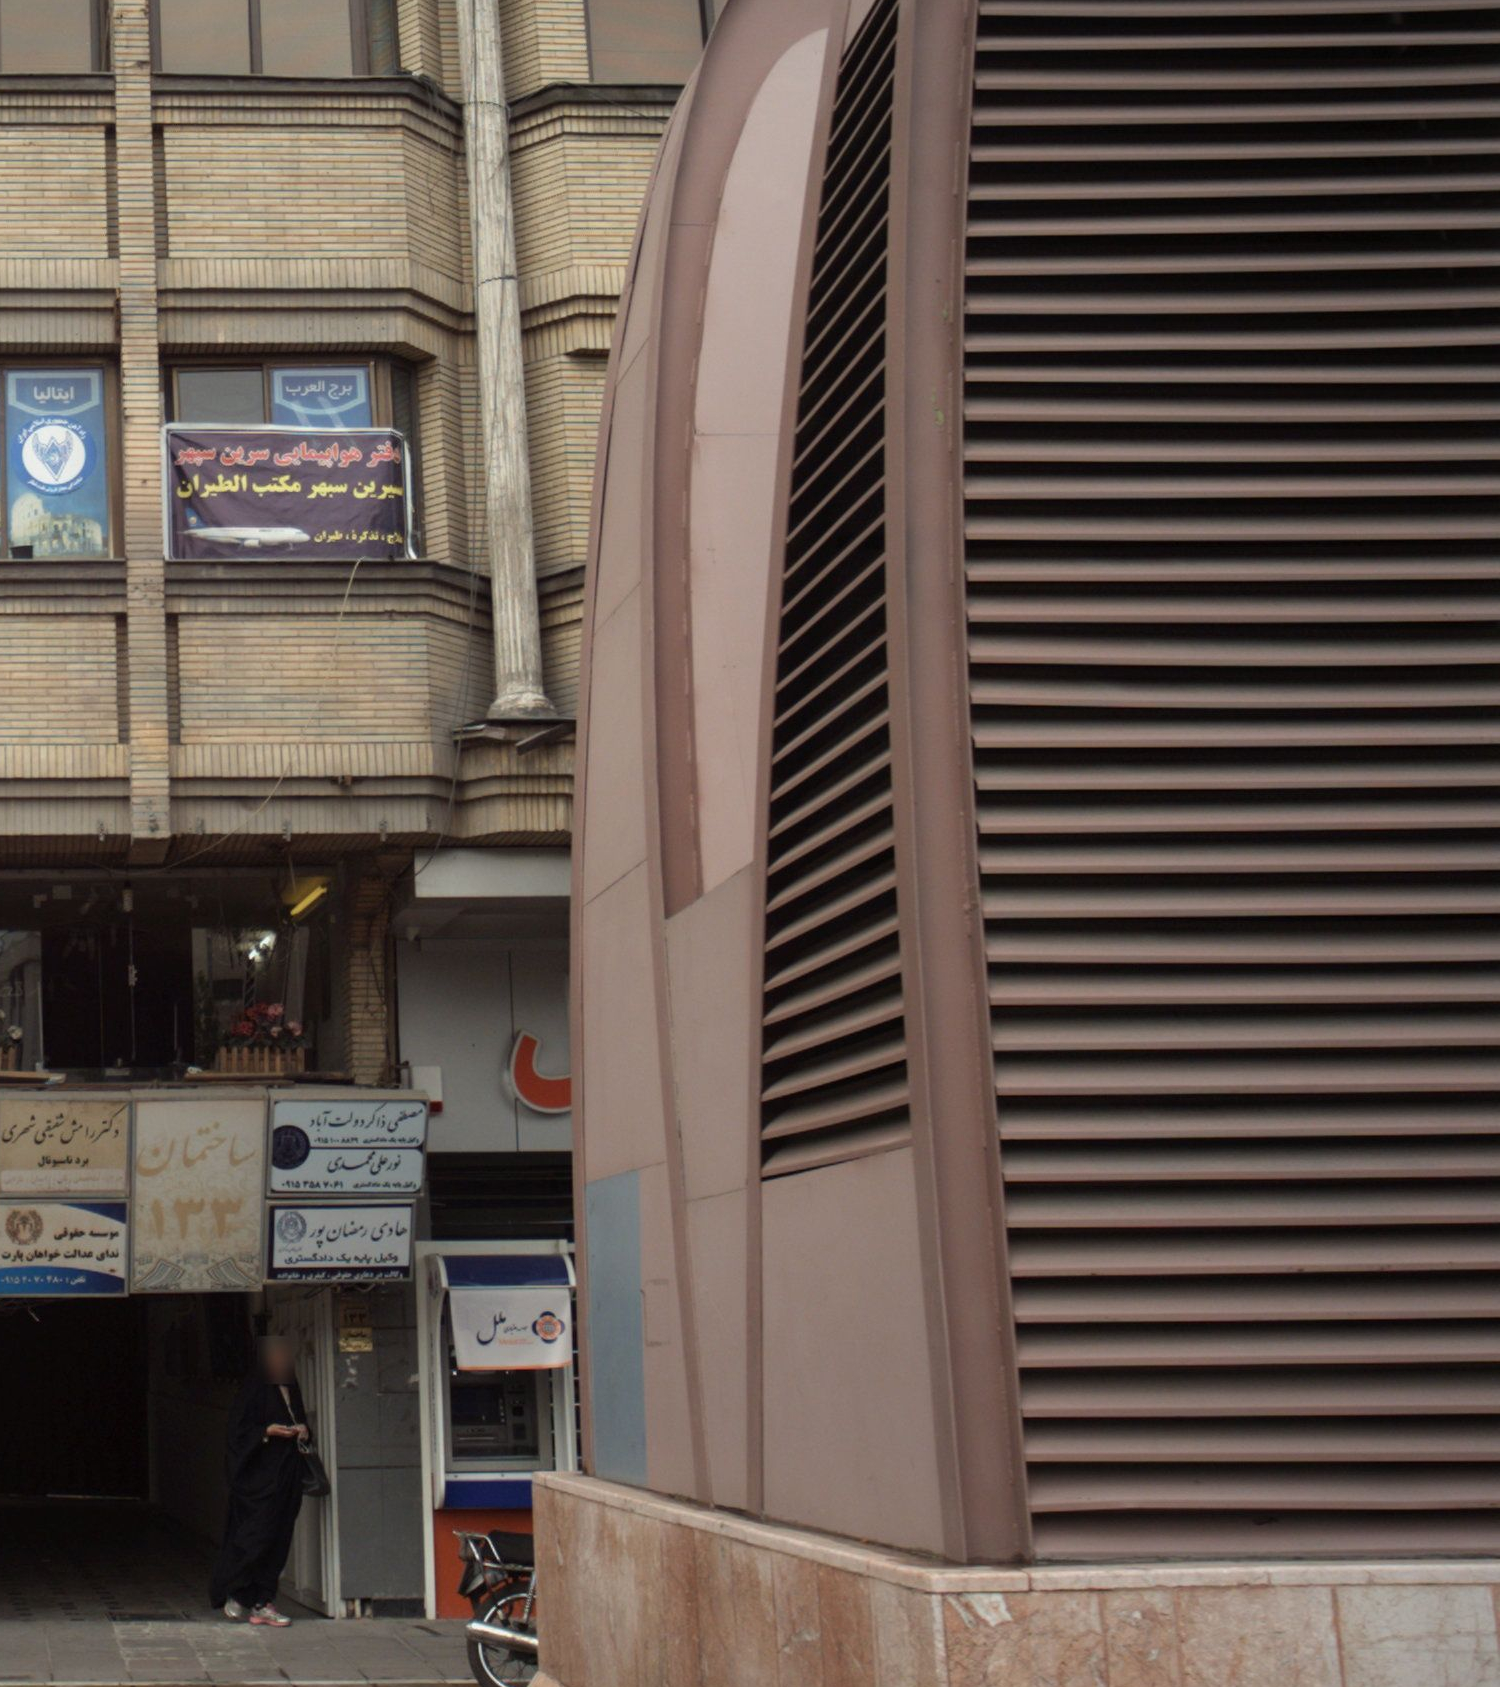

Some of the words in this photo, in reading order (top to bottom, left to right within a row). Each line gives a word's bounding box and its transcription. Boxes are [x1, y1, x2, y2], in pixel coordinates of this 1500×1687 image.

[33, 386, 75, 403] ایتالیا
[285, 380, 326, 397] العرب
[328, 382, 353, 399] برج
[274, 441, 363, 468] هواپیمایی
[90, 1103, 129, 1144] دکتر
[386, 1106, 424, 1133] مصطفی
[1, 1114, 37, 1144] شهری
[135, 1120, 257, 1178] ساختمان
[53, 1226, 86, 1241] حقوقی
[88, 1229, 120, 1241] موسسه
[308, 1224, 327, 1249] پور
[326, 1220, 369, 1242] رمضان
[370, 1220, 408, 1242] هادی
[25, 1249, 62, 1263] خواهان
[63, 1249, 94, 1260] عدالت
[95, 1249, 120, 1262] ندای
[284, 1252, 334, 1265] دادگستری
[336, 1253, 352, 1264] یک
[353, 1254, 373, 1265] پایه
[373, 1252, 399, 1264] وکیل
